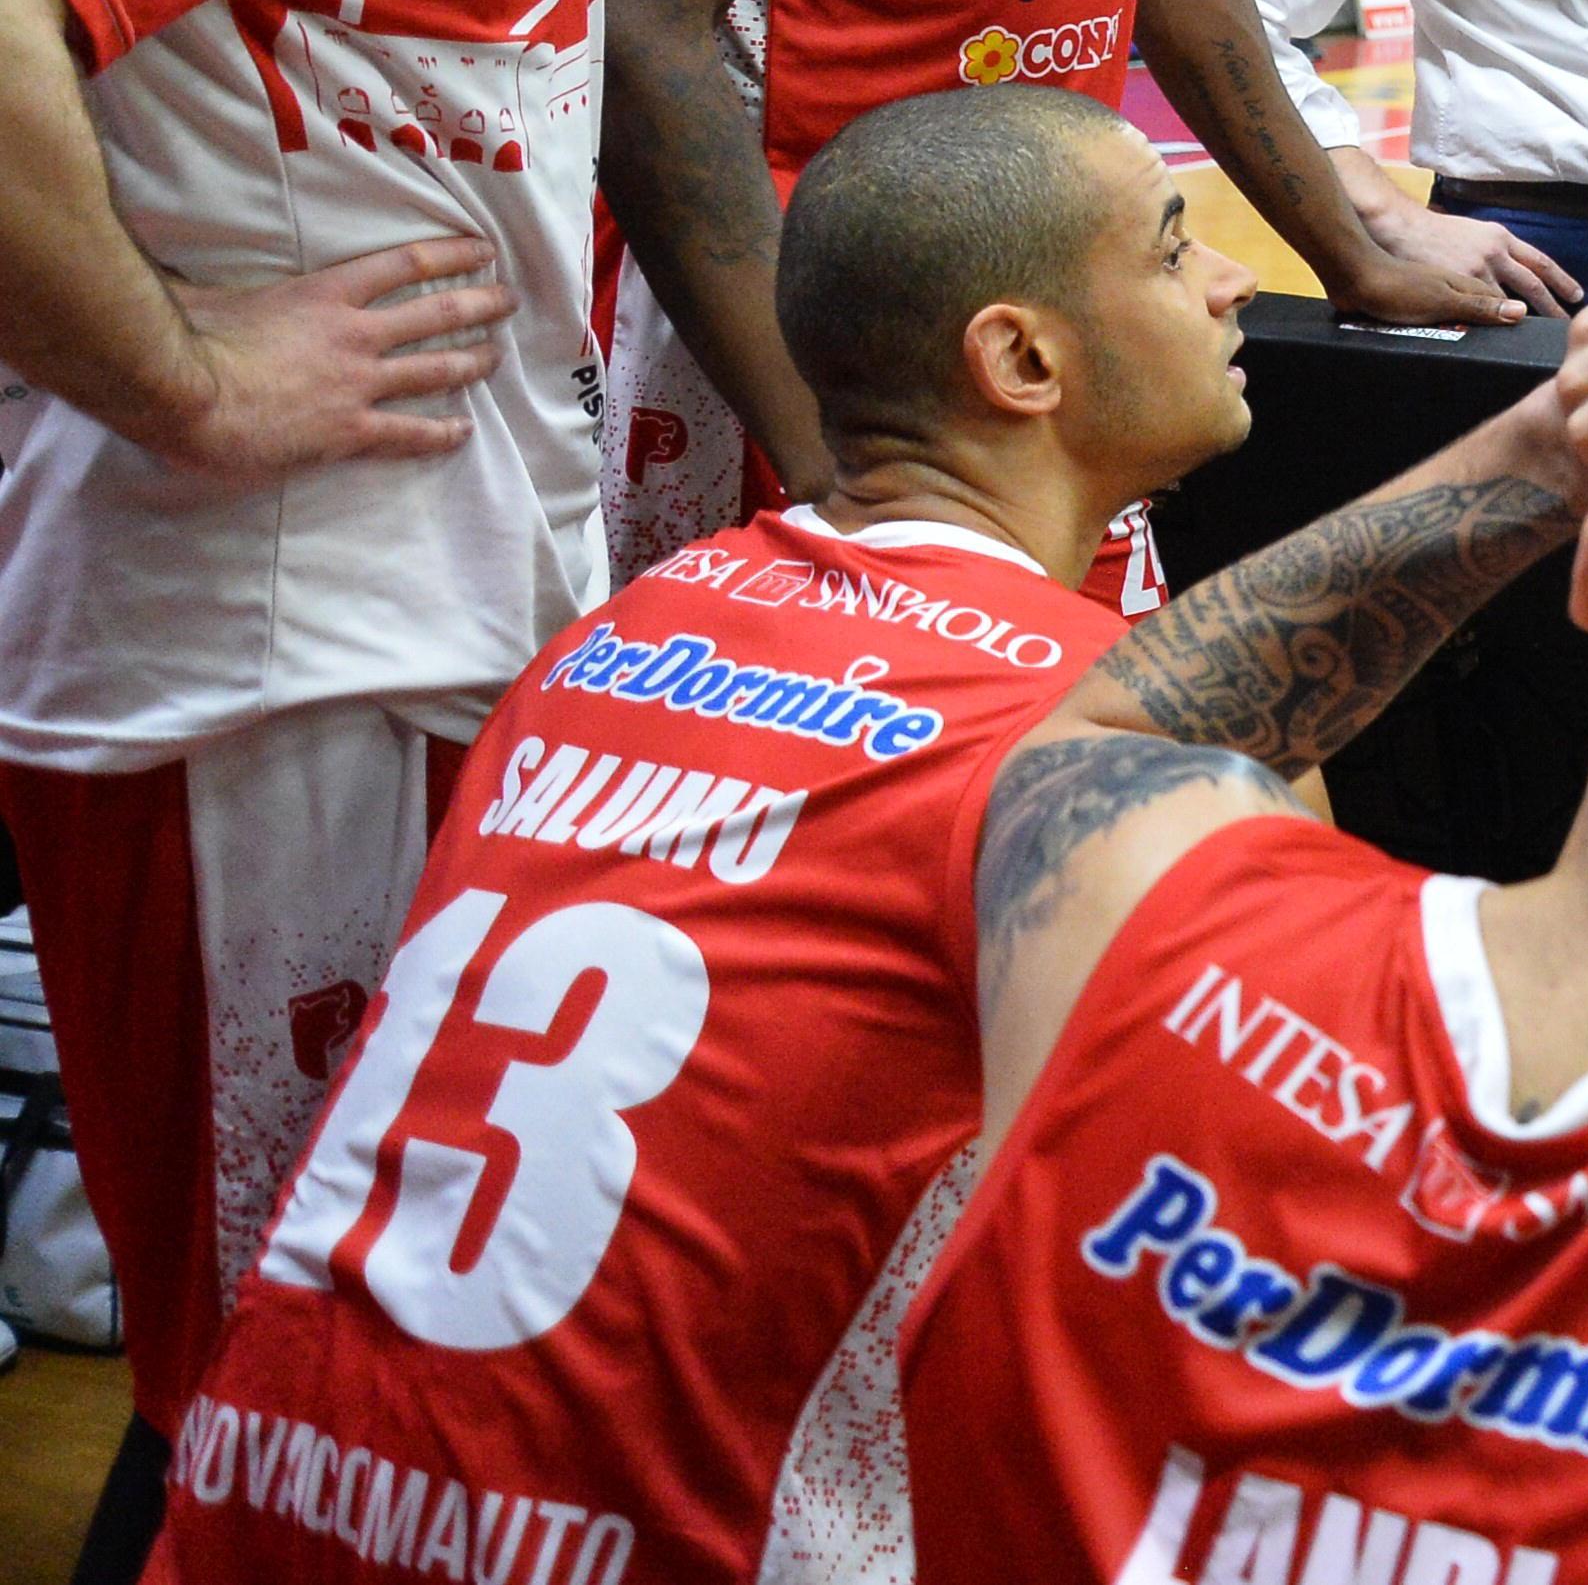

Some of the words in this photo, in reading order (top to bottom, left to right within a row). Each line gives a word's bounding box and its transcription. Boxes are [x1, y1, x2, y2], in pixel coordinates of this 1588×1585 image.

[540, 620, 945, 763] PerDormire
[798, 569, 1062, 670] SANPAOLO
[257, 887, 711, 1353] 13
[1163, 963, 1415, 1175] INTESA
